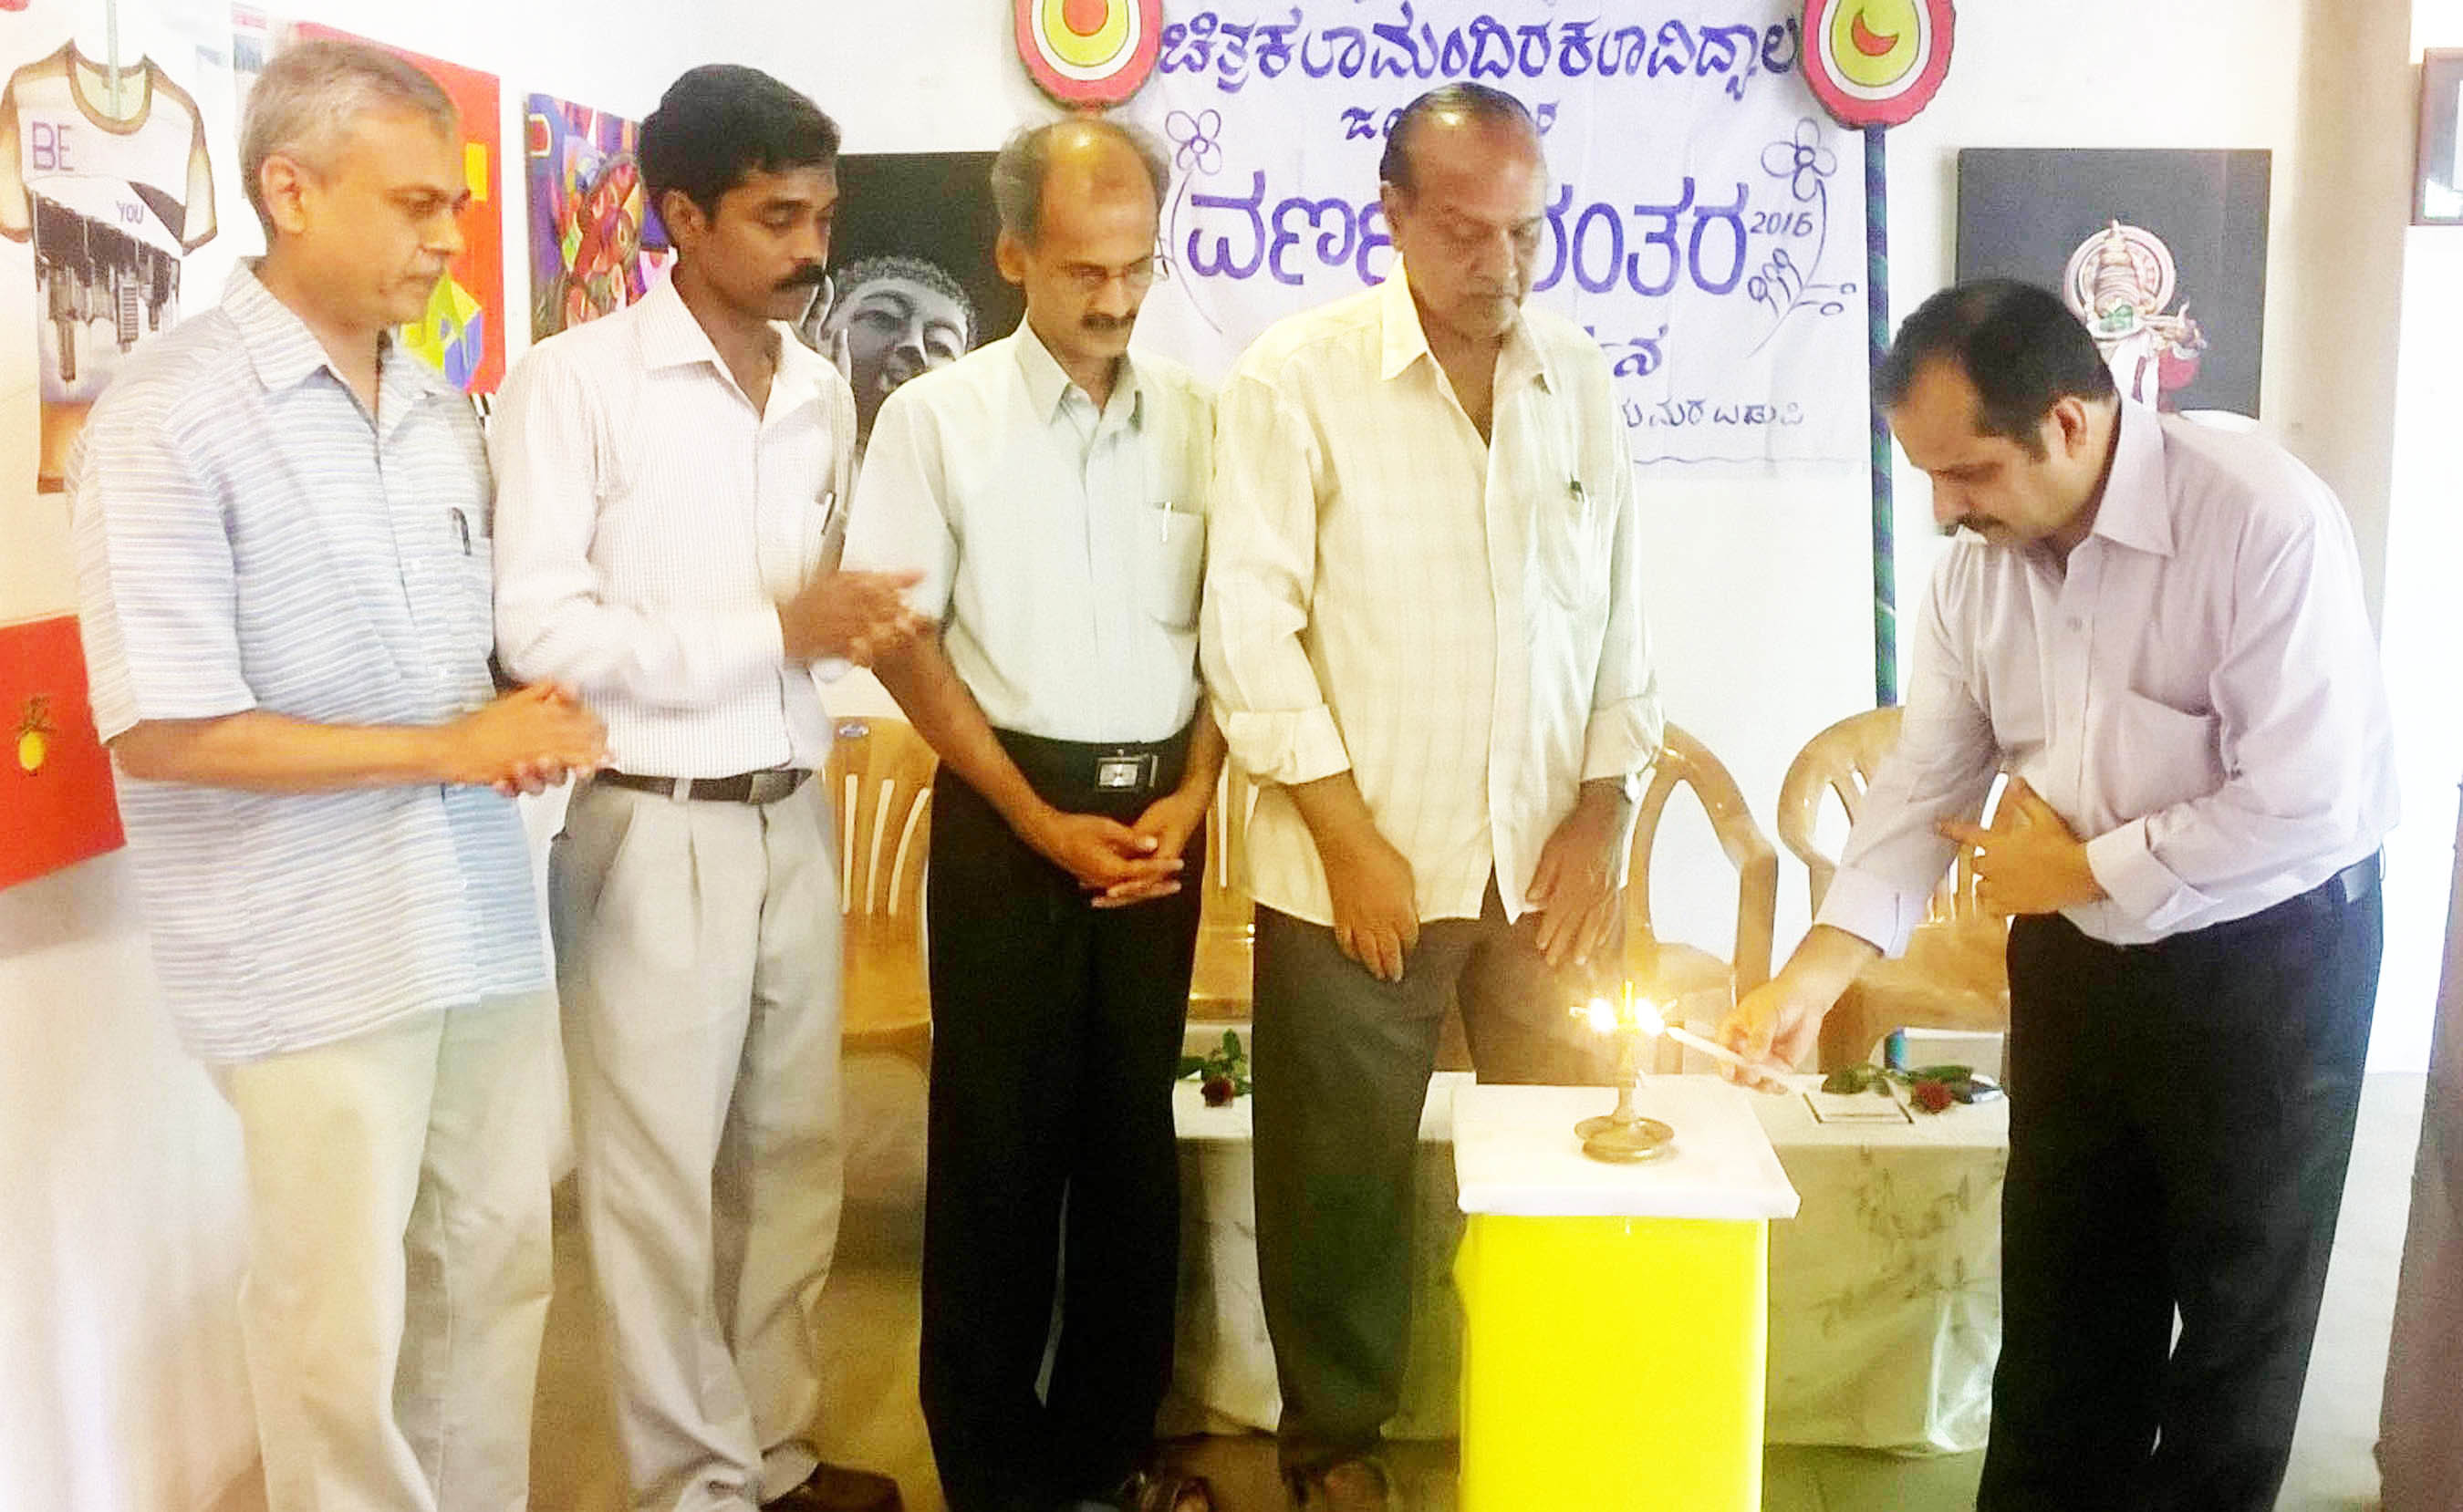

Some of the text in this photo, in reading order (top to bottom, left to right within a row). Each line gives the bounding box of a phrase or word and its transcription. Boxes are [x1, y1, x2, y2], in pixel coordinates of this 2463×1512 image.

[32, 120, 75, 171] BE
[116, 200, 144, 224] YOU
[1751, 211, 1813, 237] 2016
